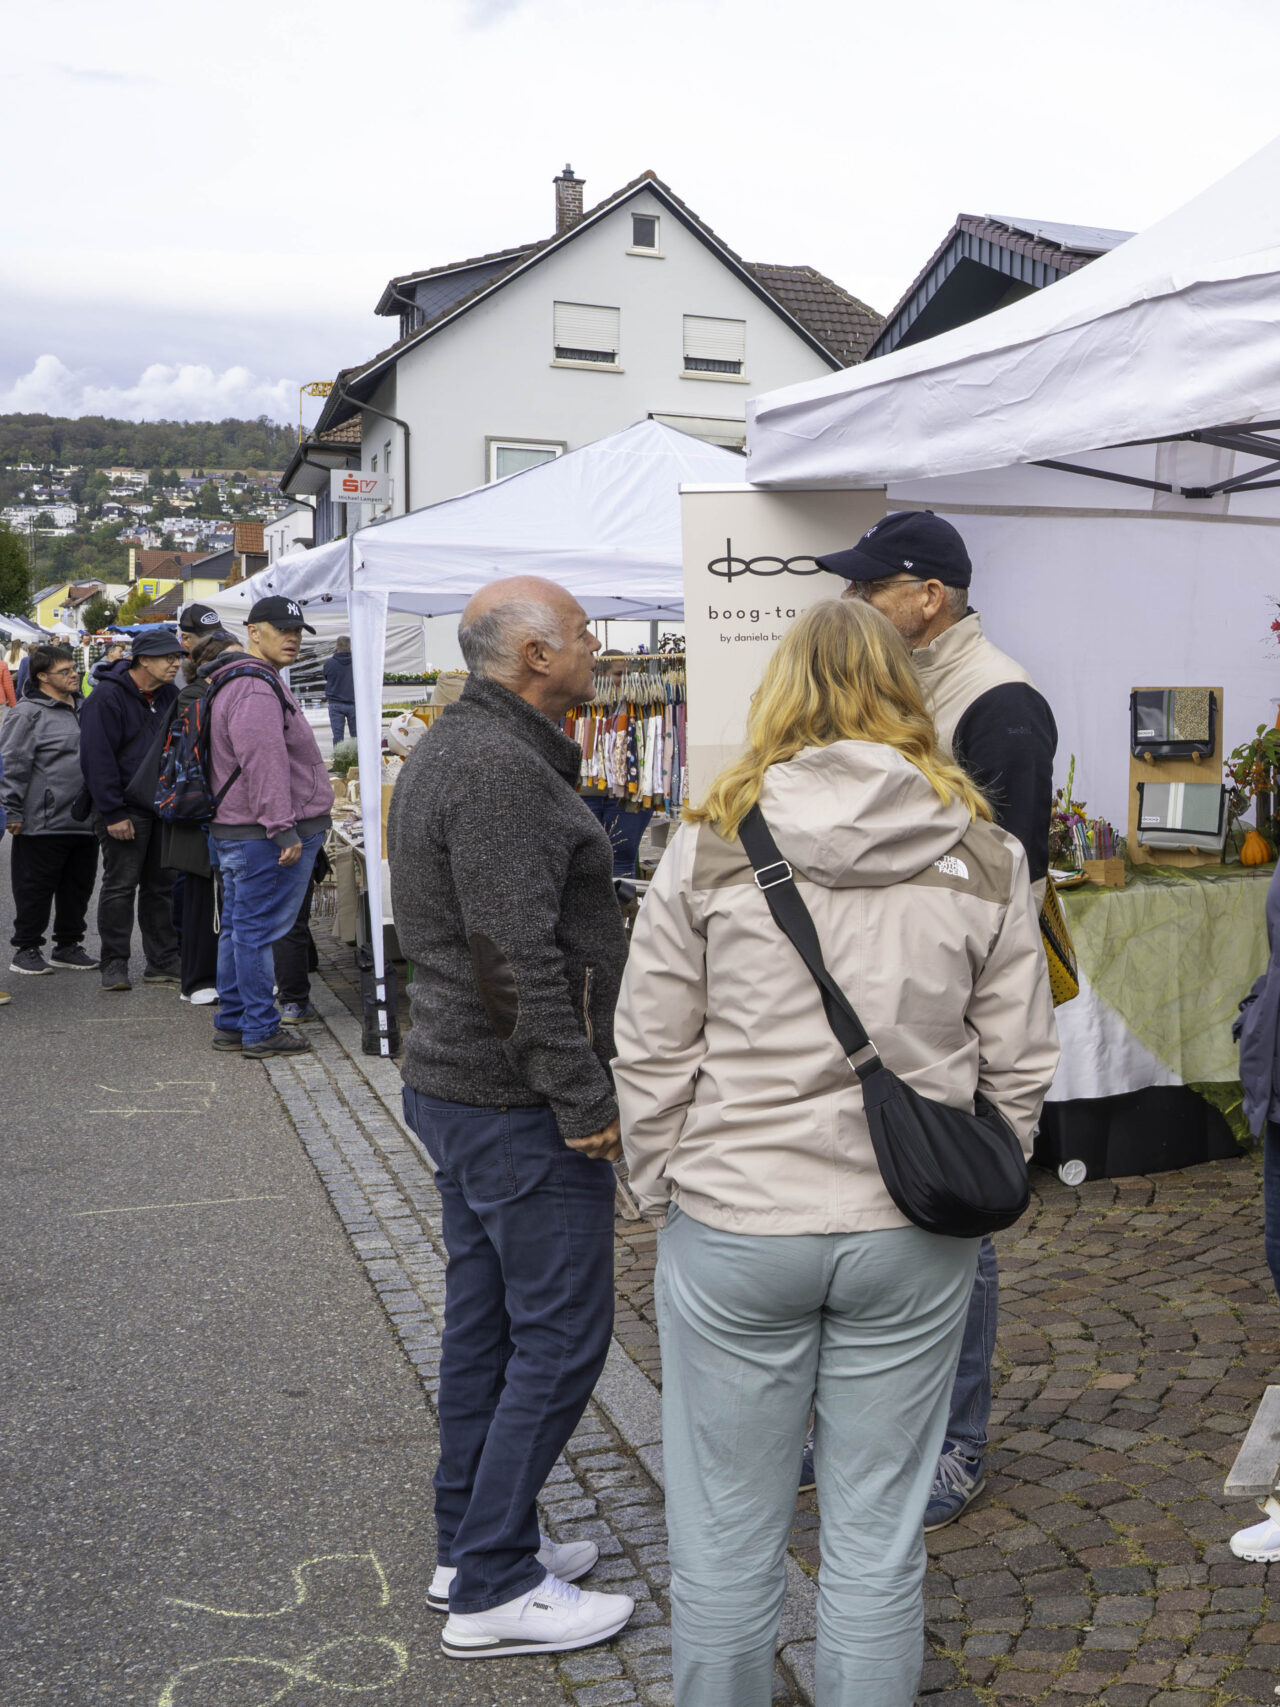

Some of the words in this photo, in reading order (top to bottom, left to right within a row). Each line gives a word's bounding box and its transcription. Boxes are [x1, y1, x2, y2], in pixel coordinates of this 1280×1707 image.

[720, 633, 731, 643] by
[734, 632, 769, 642] daniela
[939, 865, 959, 876] FACE
